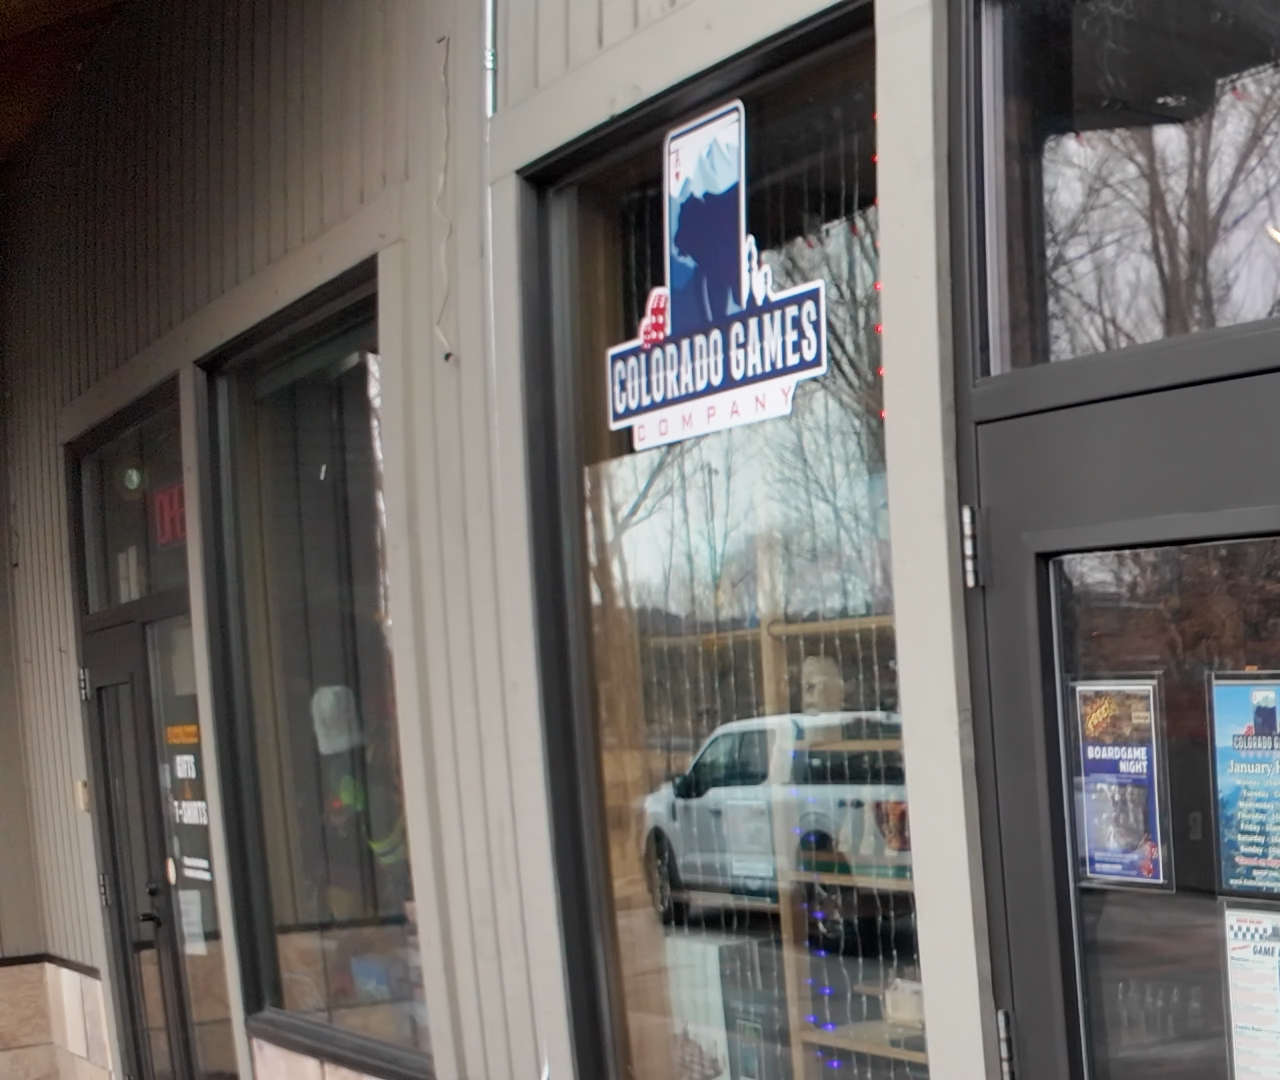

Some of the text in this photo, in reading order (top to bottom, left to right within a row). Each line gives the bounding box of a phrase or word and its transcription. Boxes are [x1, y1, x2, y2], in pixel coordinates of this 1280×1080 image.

[613, 299, 818, 415] COLORADO GAMES
[637, 386, 792, 443] COMPANY
[1234, 735, 1273, 750] COLORADO
[1087, 745, 1147, 760] BOARDGAME
[1119, 760, 1148, 774] NIGHT
[1228, 759, 1273, 777] January
[1252, 945, 1276, 958] GAME
